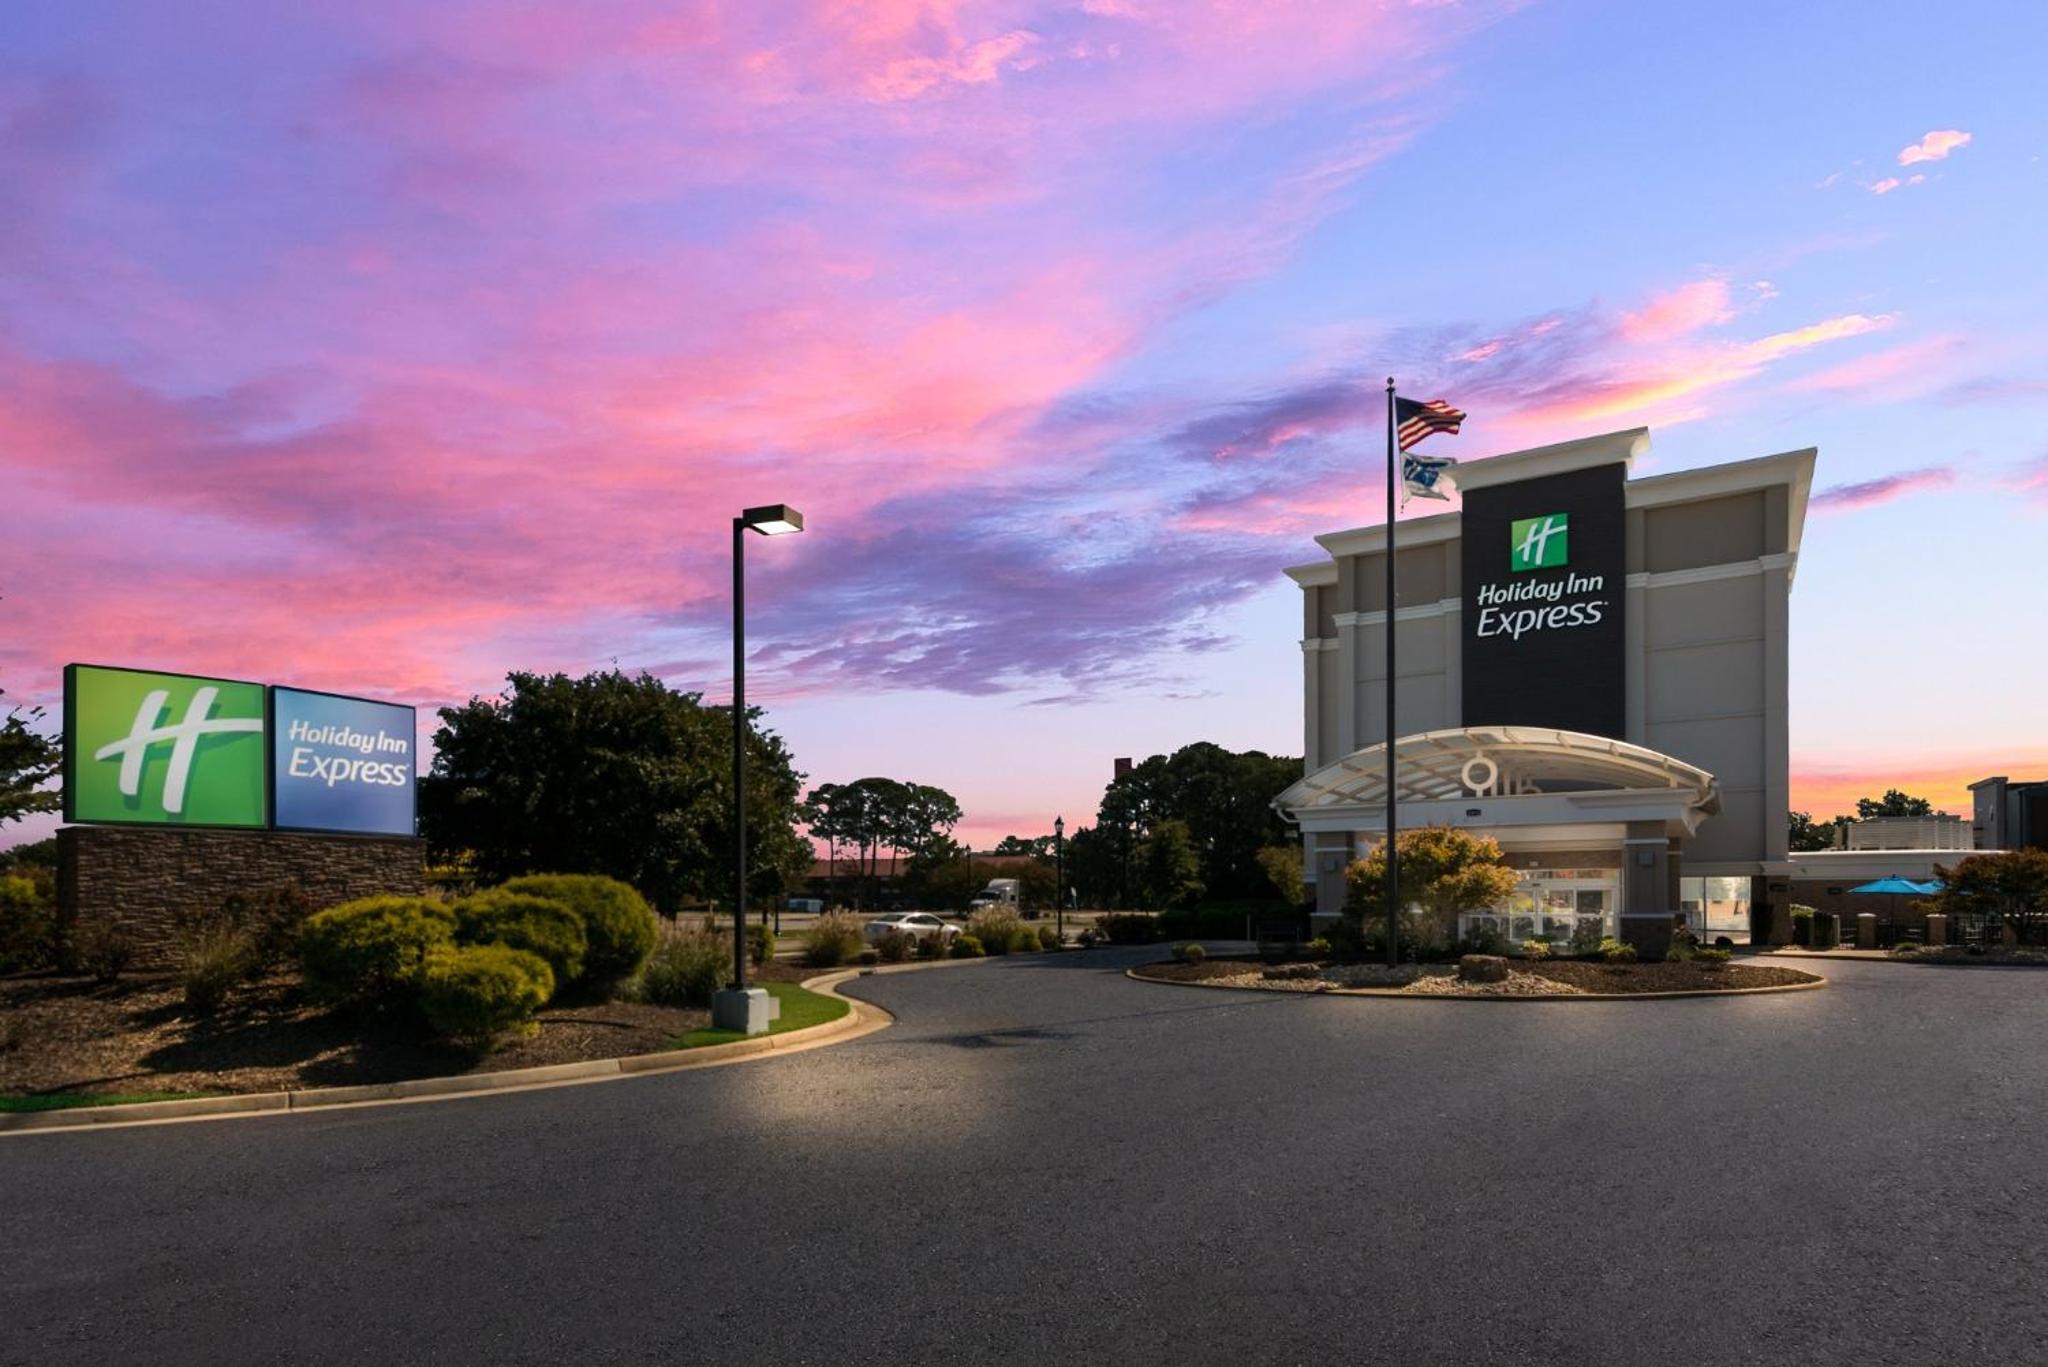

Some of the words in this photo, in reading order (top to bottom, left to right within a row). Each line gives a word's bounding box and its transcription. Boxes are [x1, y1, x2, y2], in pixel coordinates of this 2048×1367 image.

[1477, 579, 1563, 605] Holiday
[1566, 573, 1603, 595] Inn
[1477, 601, 1602, 640] Express
[288, 720, 375, 753] Holiday
[377, 730, 407, 754] Inn
[288, 746, 407, 787] Express
